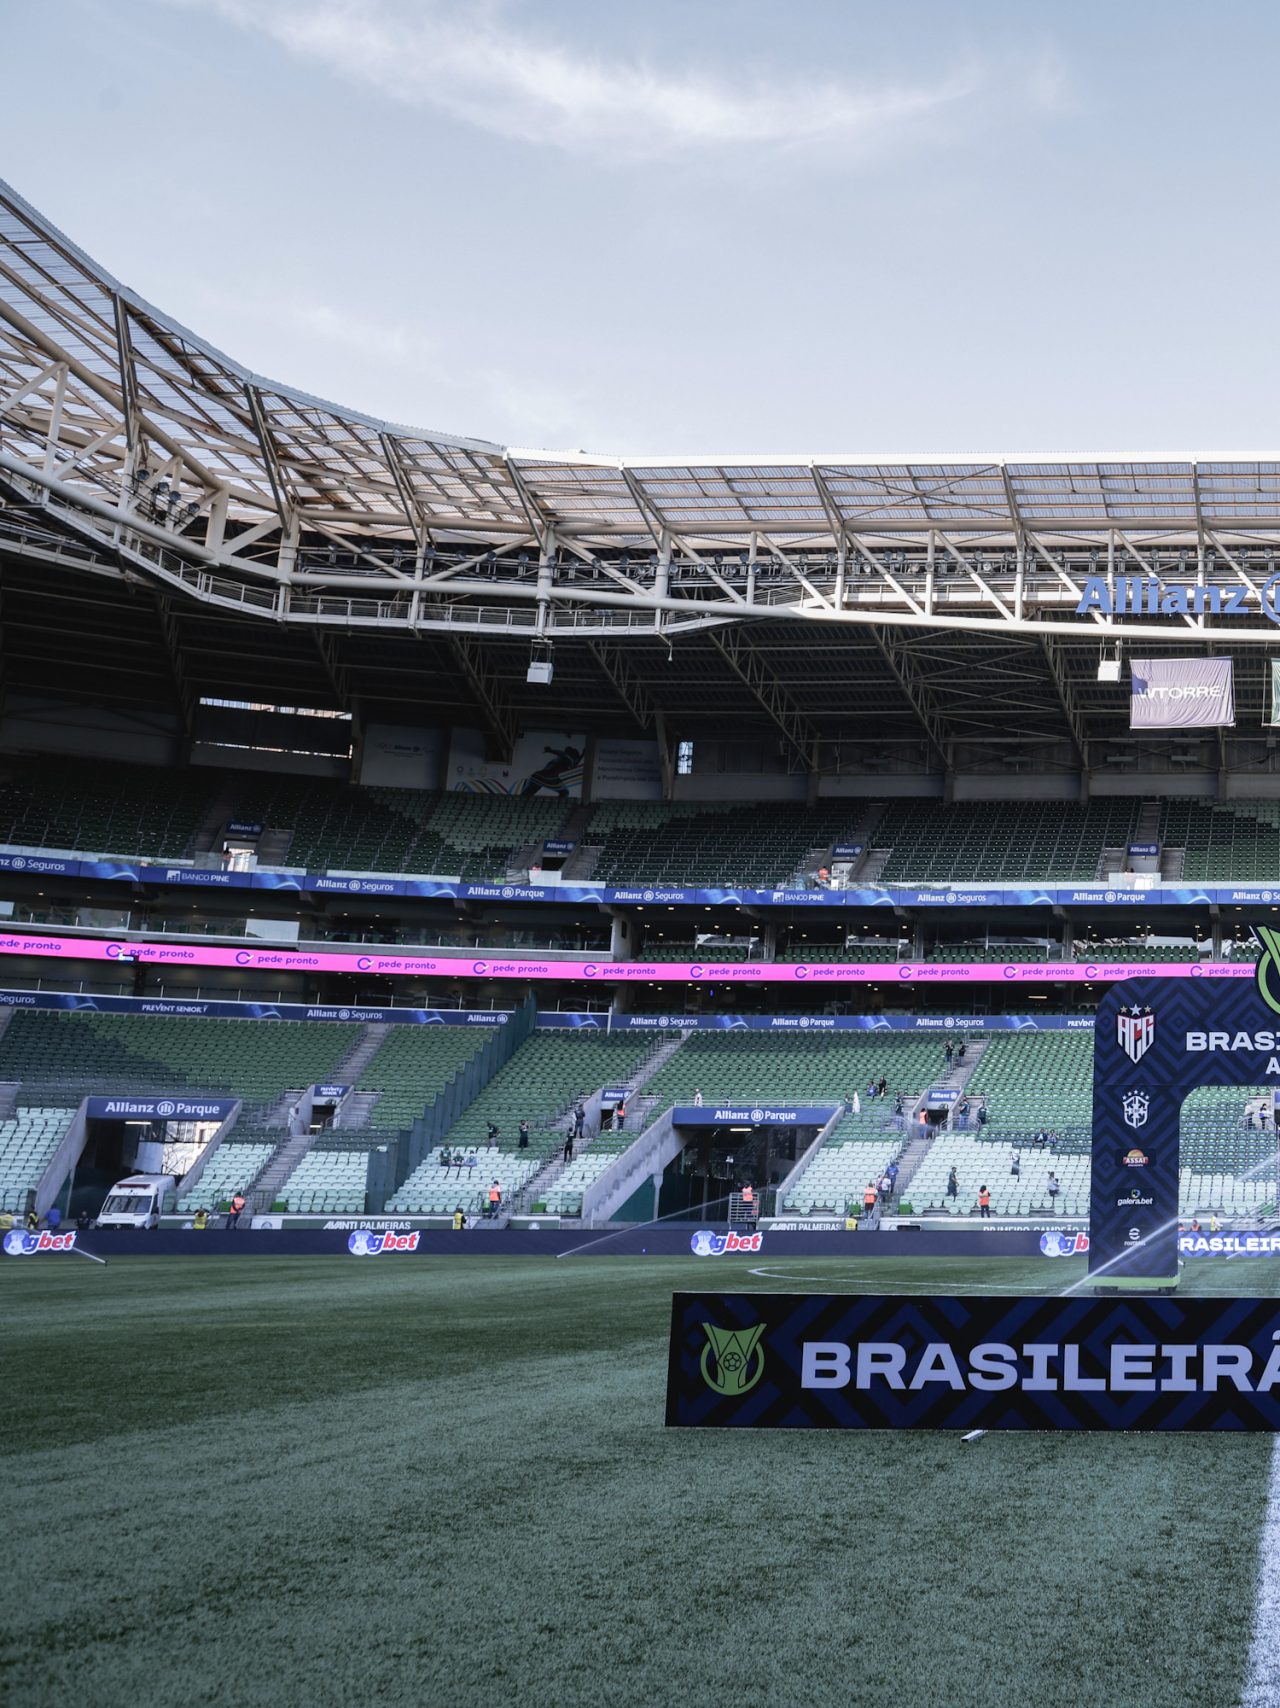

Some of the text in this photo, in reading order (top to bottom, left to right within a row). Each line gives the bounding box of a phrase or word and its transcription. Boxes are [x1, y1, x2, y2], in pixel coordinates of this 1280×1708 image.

[1076, 576, 1249, 614] Allianz
[28, 860, 65, 871] Seguros
[182, 873, 230, 882] BANCO PINE
[316, 880, 394, 892] Allianz Seguros
[468, 887, 544, 898] Allianz Parque
[614, 892, 684, 901] Allianz Seguros
[1232, 892, 1260, 900] Allianz
[918, 894, 986, 903] Allianz Seguros
[1073, 892, 1145, 903] Allianz Parque
[24, 941, 62, 950] pronto
[160, 949, 194, 958] pronto
[258, 955, 318, 965] pede pronto
[378, 960, 436, 970] pede pronto
[493, 964, 548, 974] pede pronto
[603, 967, 656, 976] pede pronto
[709, 968, 761, 976] pede pronto
[814, 968, 865, 976] pede pronto
[918, 968, 970, 976] pede pronto
[1022, 968, 1074, 976] pede pronto
[1104, 968, 1156, 976] pede pronto
[1209, 967, 1256, 976] pede pront
[0, 994, 36, 1004] Seguros
[142, 1004, 174, 1012] PREVENT
[307, 1009, 382, 1020] Allianz Seguros
[468, 1014, 495, 1022] Allianz
[630, 1018, 698, 1027] Allianz Seguros
[772, 1018, 834, 1028] Allianz Parque
[916, 1018, 984, 1028] Allianz Seguros
[105, 1101, 220, 1116] Allianz Parque
[714, 1110, 796, 1122] Allianz Parque
[1118, 1198, 1152, 1206] galera.bet
[323, 1221, 410, 1229] AVANTI PALMEIRAS
